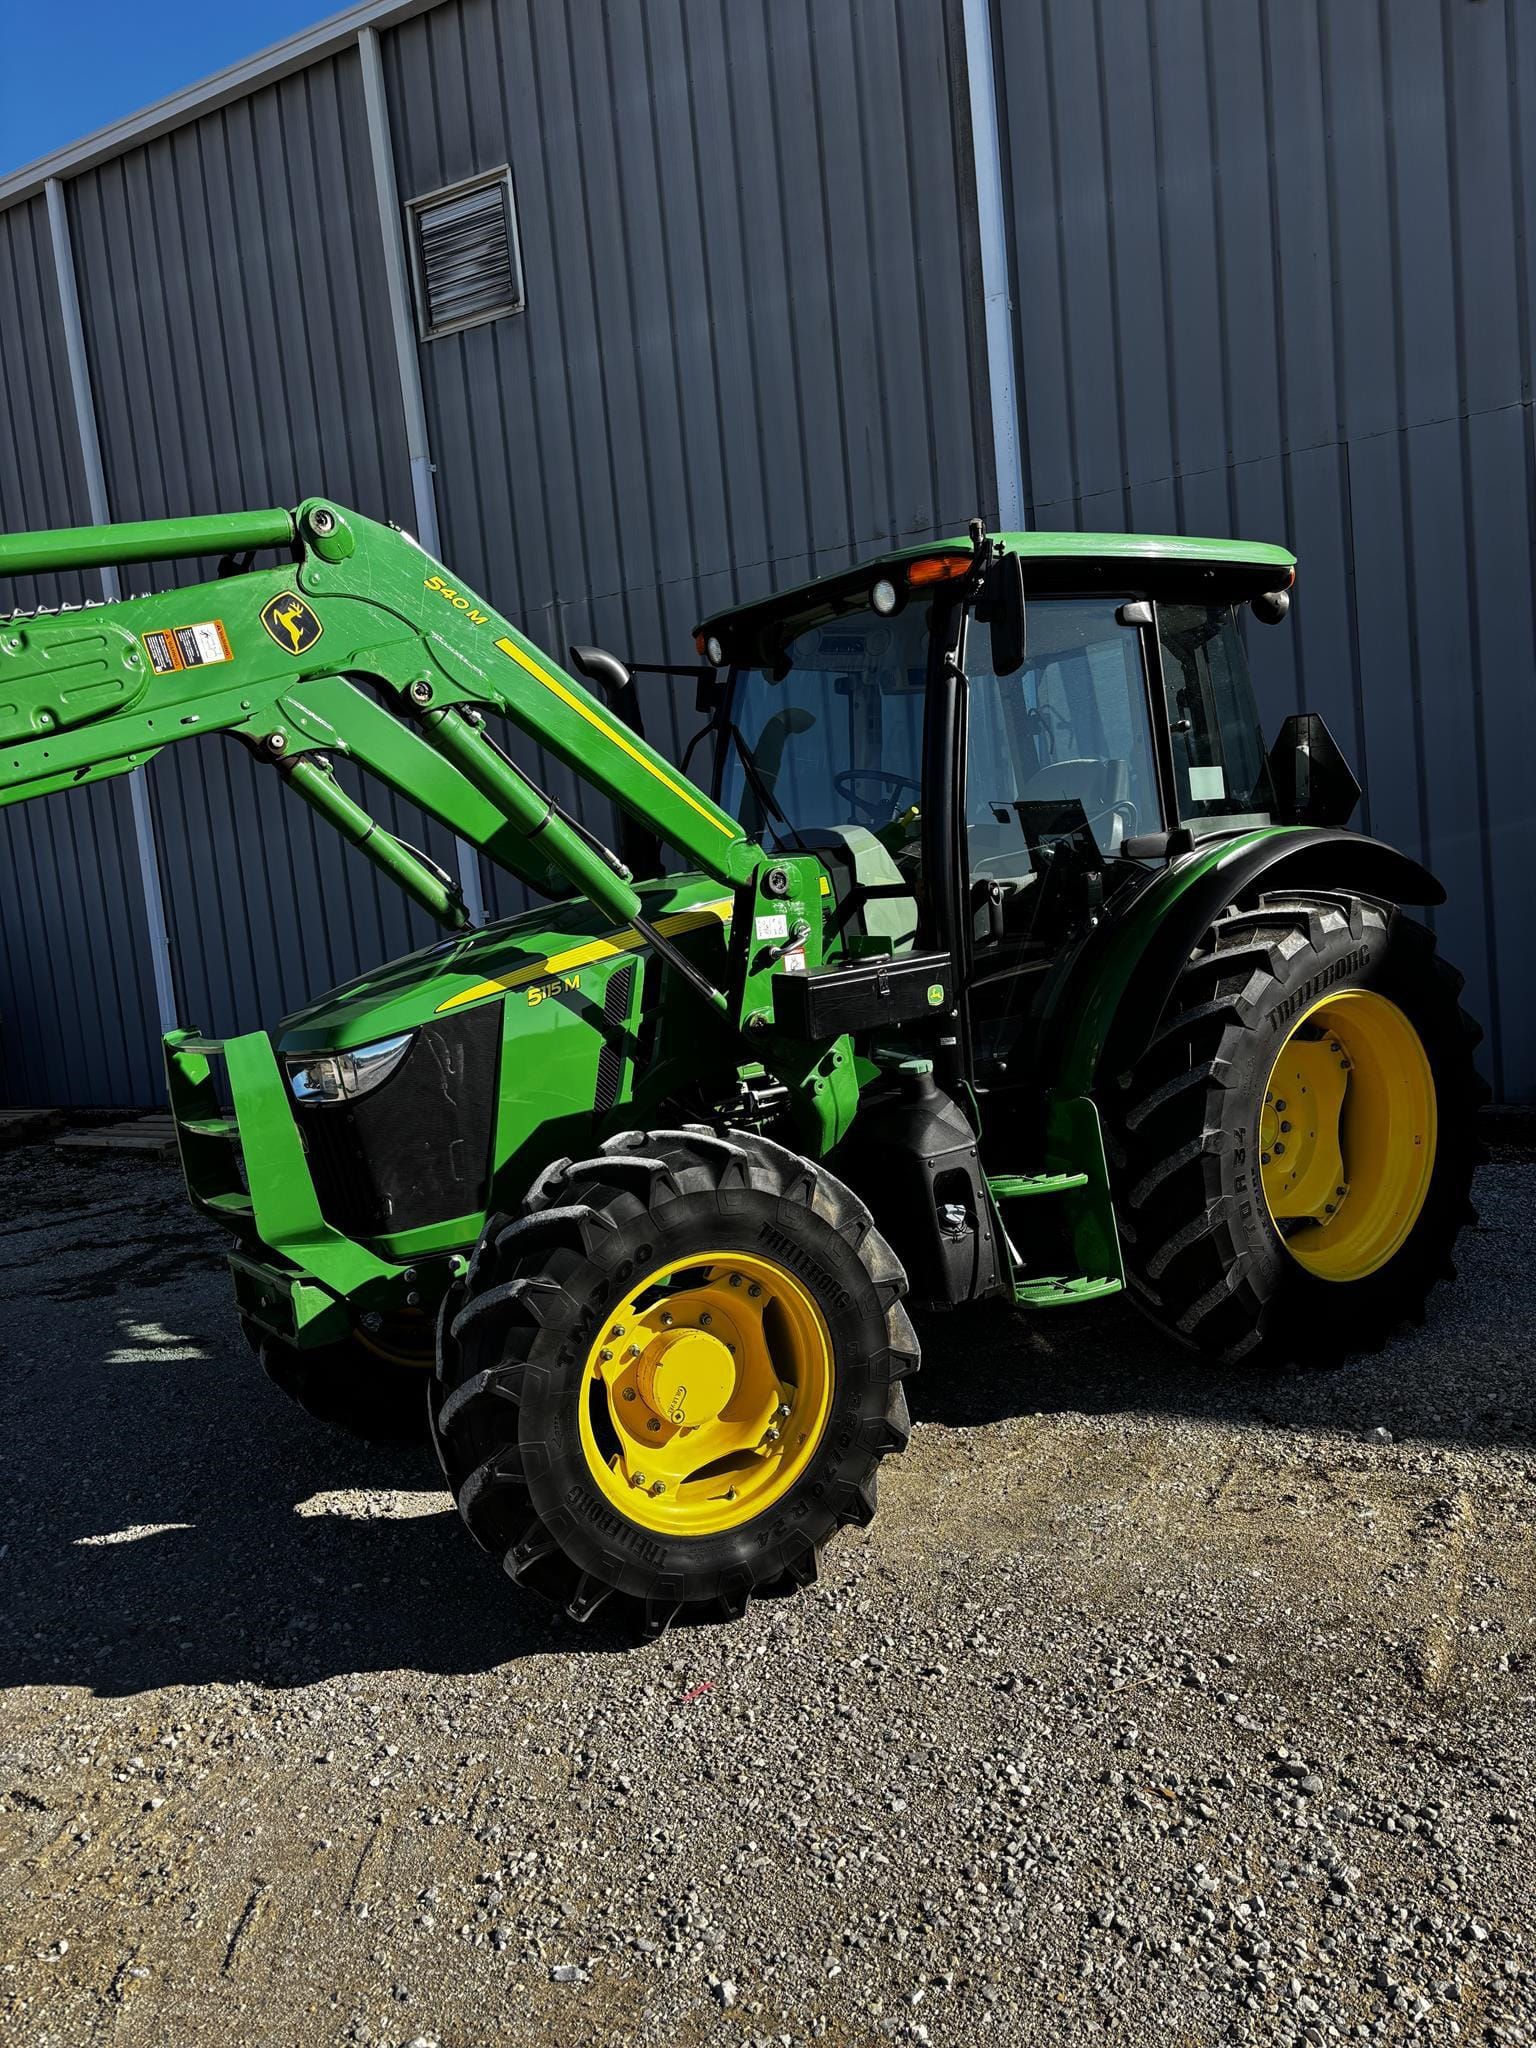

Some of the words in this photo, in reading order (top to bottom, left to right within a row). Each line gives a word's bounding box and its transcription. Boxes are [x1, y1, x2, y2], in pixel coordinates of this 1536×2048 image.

[423, 575, 470, 610] 540
[464, 609, 490, 626] M
[527, 980, 562, 1007] 5115
[564, 974, 581, 992] M
[1264, 944, 1370, 1033] TRELLEBORG
[757, 1220, 851, 1309] TRELLEBORG
[565, 1485, 669, 1571] TRELLEBORG
